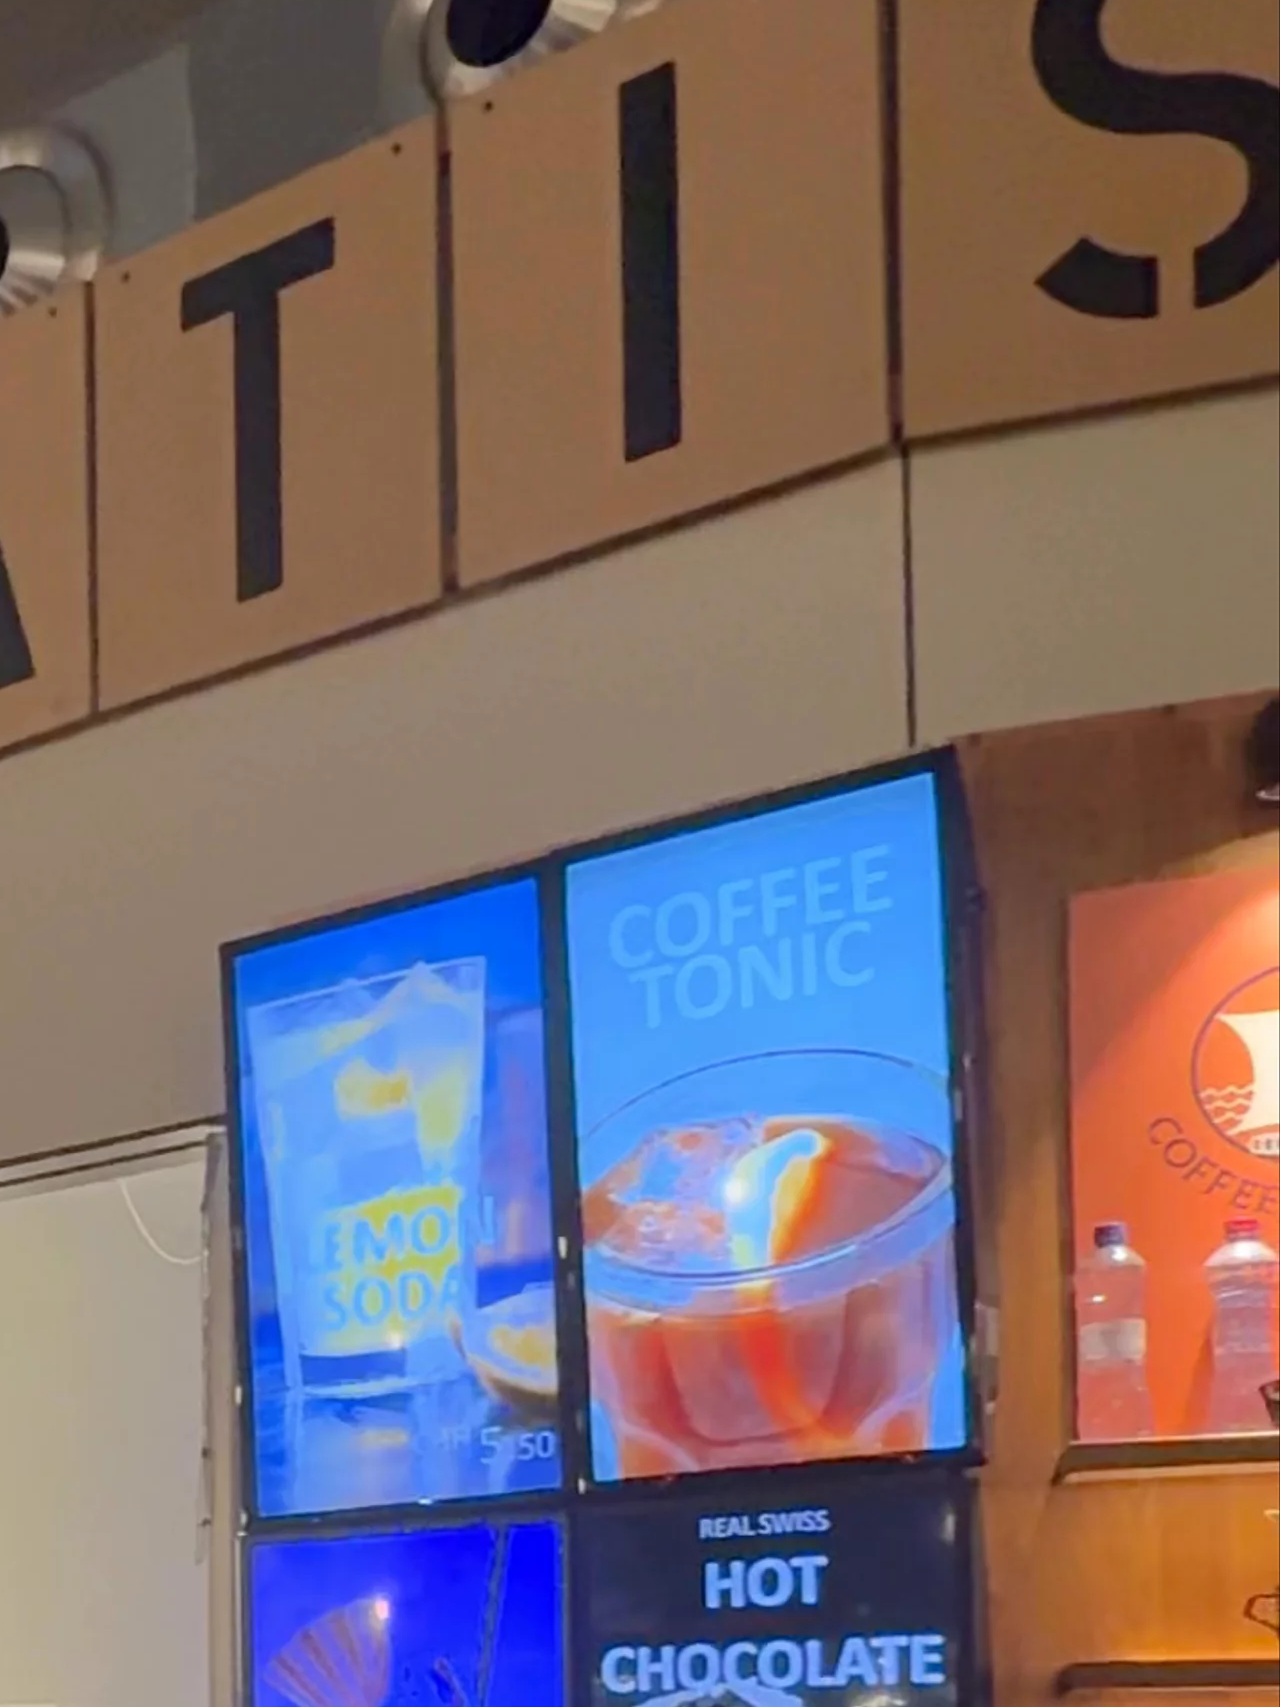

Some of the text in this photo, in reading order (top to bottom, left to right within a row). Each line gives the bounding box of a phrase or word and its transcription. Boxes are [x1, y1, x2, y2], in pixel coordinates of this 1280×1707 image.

[608, 844, 894, 971] COFFEE
[628, 920, 874, 1029] TONIC
[699, 1509, 832, 1539] REAL SWISS
[704, 1555, 829, 1610] HOT
[600, 1633, 947, 1695] CHOCOLATE
